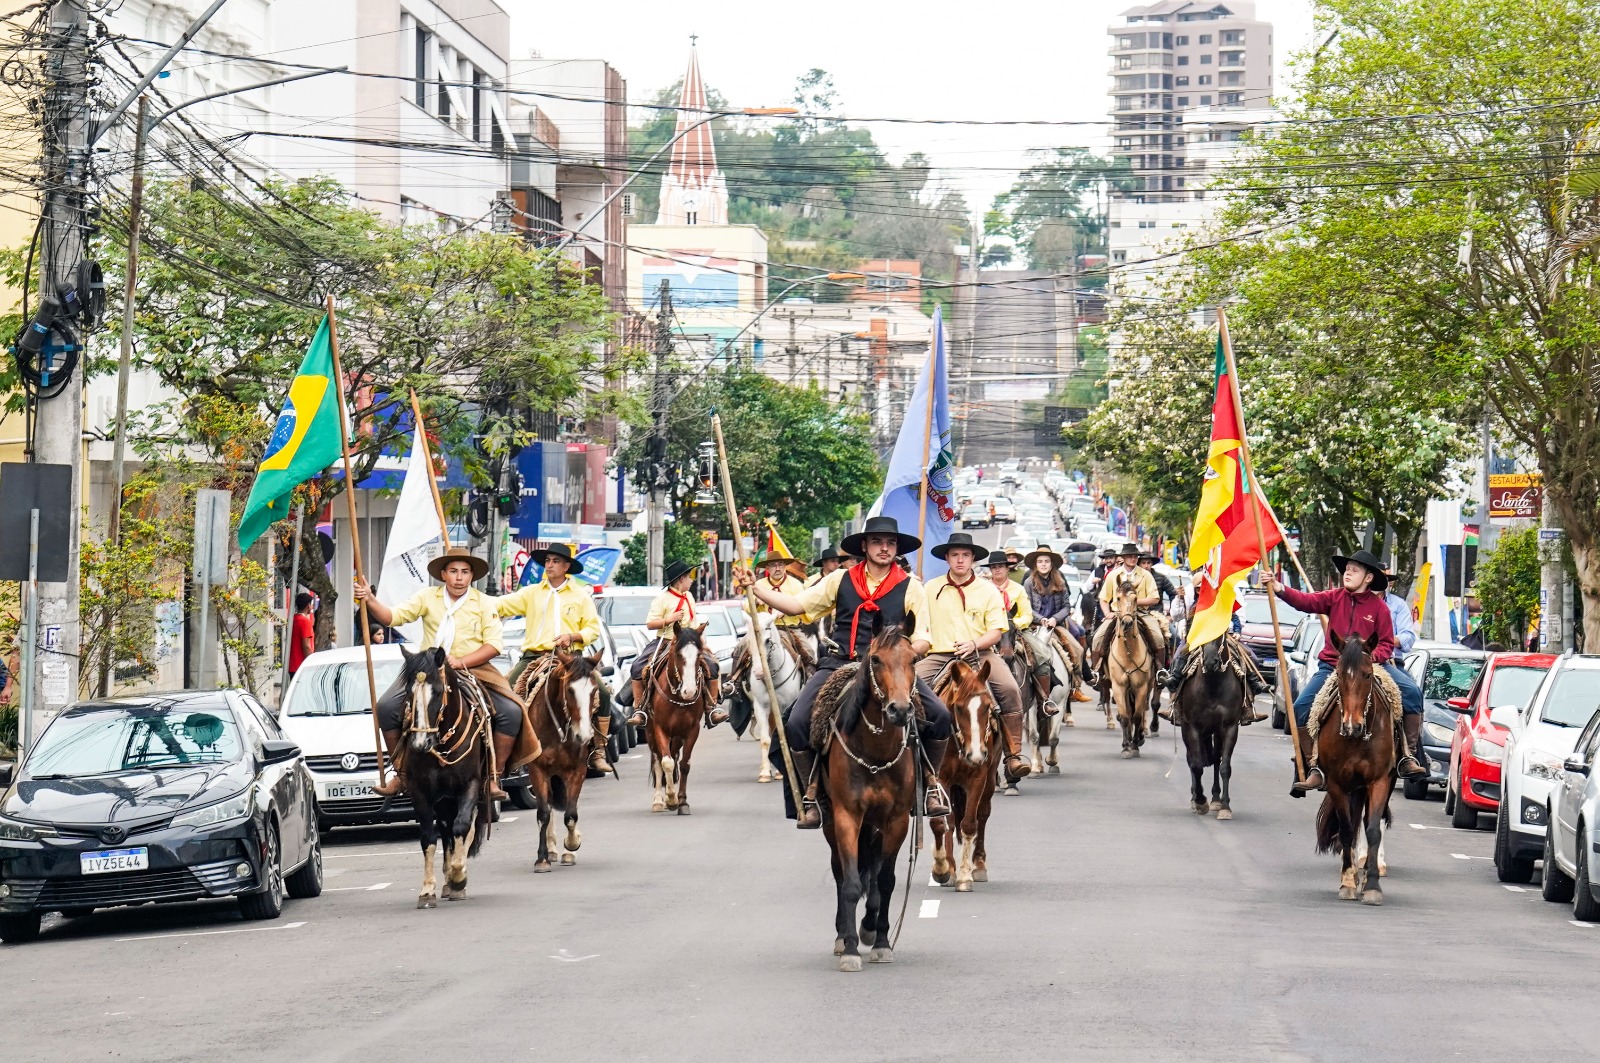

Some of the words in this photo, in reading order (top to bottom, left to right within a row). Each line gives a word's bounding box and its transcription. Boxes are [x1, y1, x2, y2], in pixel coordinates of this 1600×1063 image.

[1489, 476, 1540, 485] RESTAURAN
[1492, 488, 1539, 509] Santo
[88, 855, 141, 872] IYZ5E44
